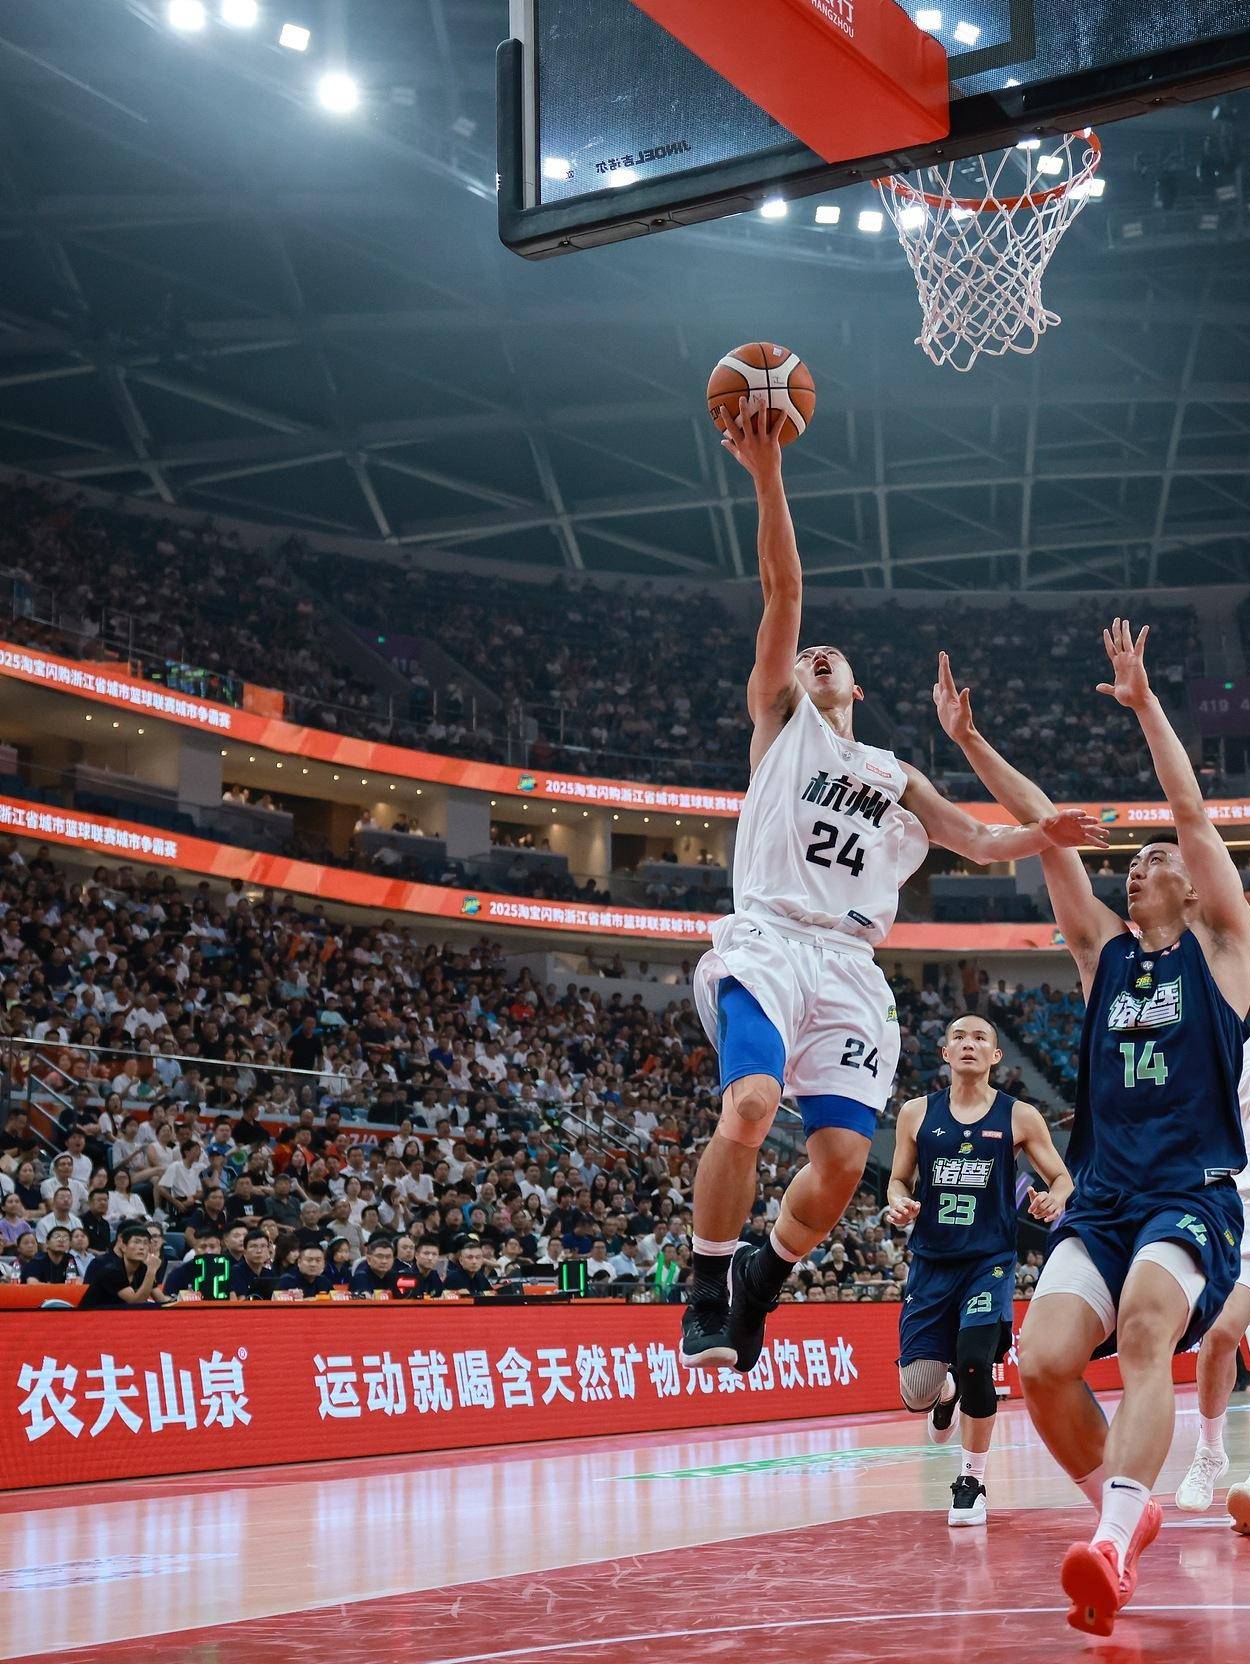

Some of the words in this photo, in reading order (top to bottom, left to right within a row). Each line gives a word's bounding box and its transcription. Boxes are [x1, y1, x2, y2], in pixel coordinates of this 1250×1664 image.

[800, 770, 893, 829] 杭州
[805, 820, 865, 877] 24
[840, 1037, 878, 1079] 24
[1119, 1040, 1169, 1088] 14
[931, 1157, 995, 1189] 诸暨
[938, 1192, 977, 1226] 23
[966, 1291, 993, 1315] 23
[16, 1349, 252, 1442] 农夫山泉
